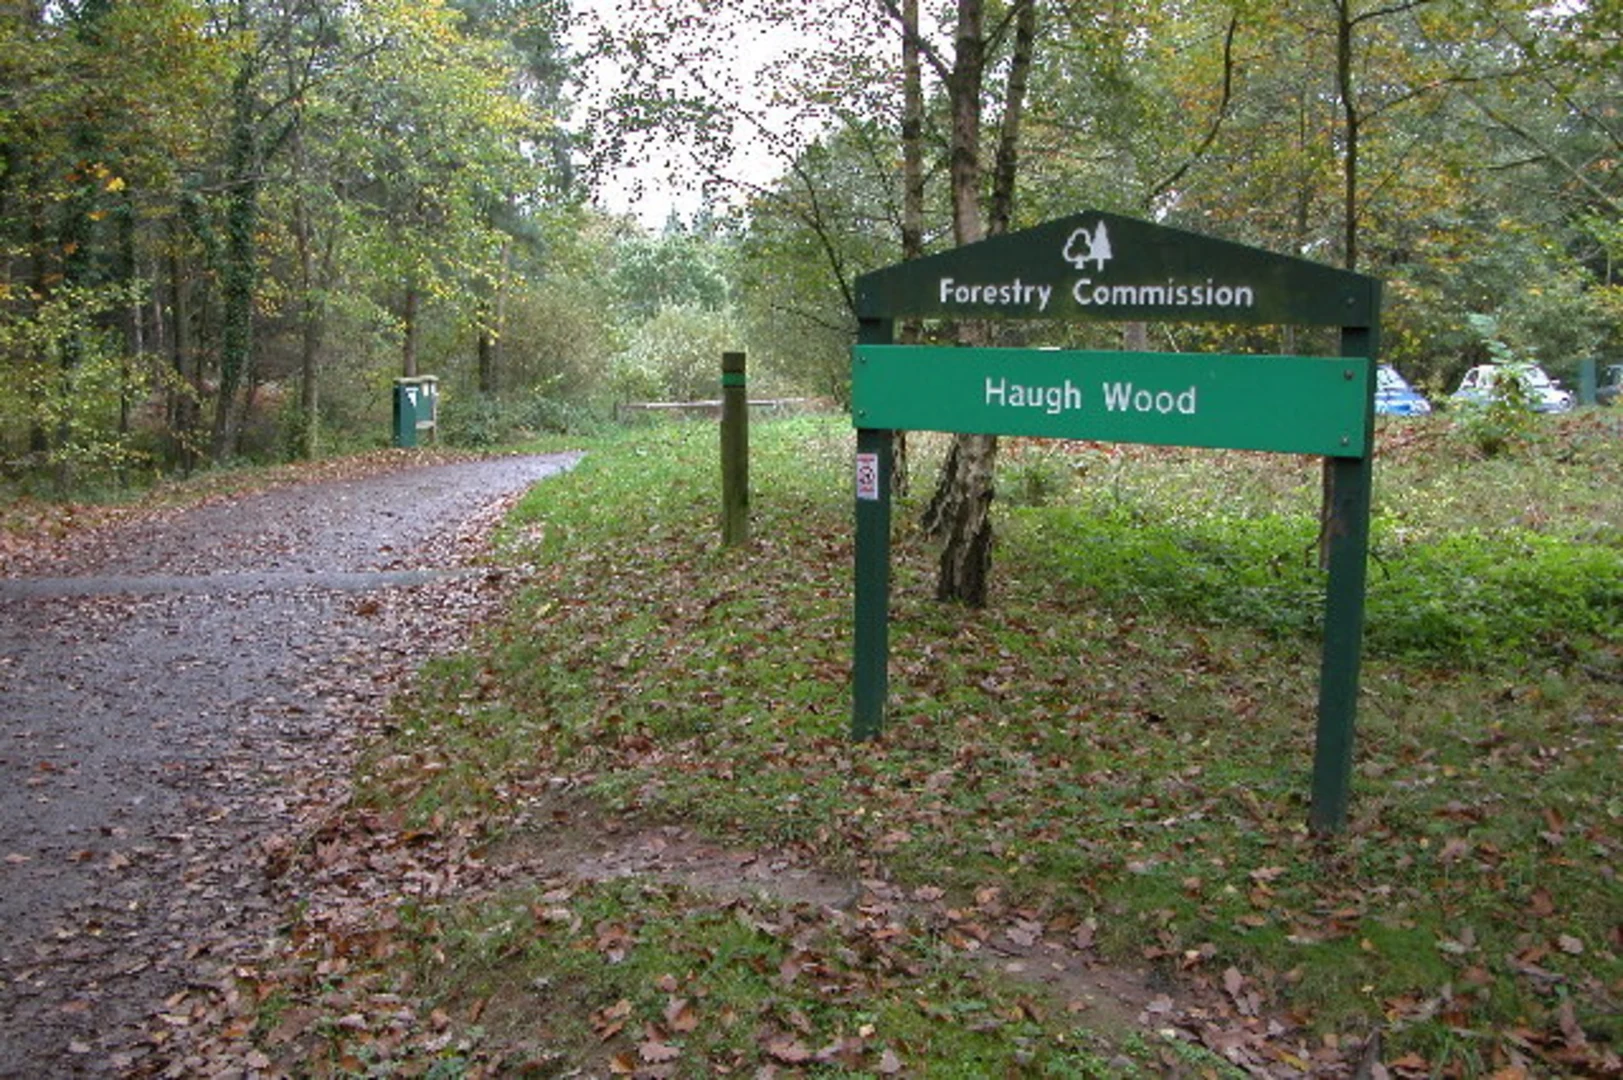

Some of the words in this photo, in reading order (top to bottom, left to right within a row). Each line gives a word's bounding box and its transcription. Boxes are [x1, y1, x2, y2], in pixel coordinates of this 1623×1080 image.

[939, 277, 1052, 312] Forestry
[1072, 278, 1253, 307] Commission
[985, 377, 1081, 415] Haugh
[1103, 382, 1196, 414] Wood
